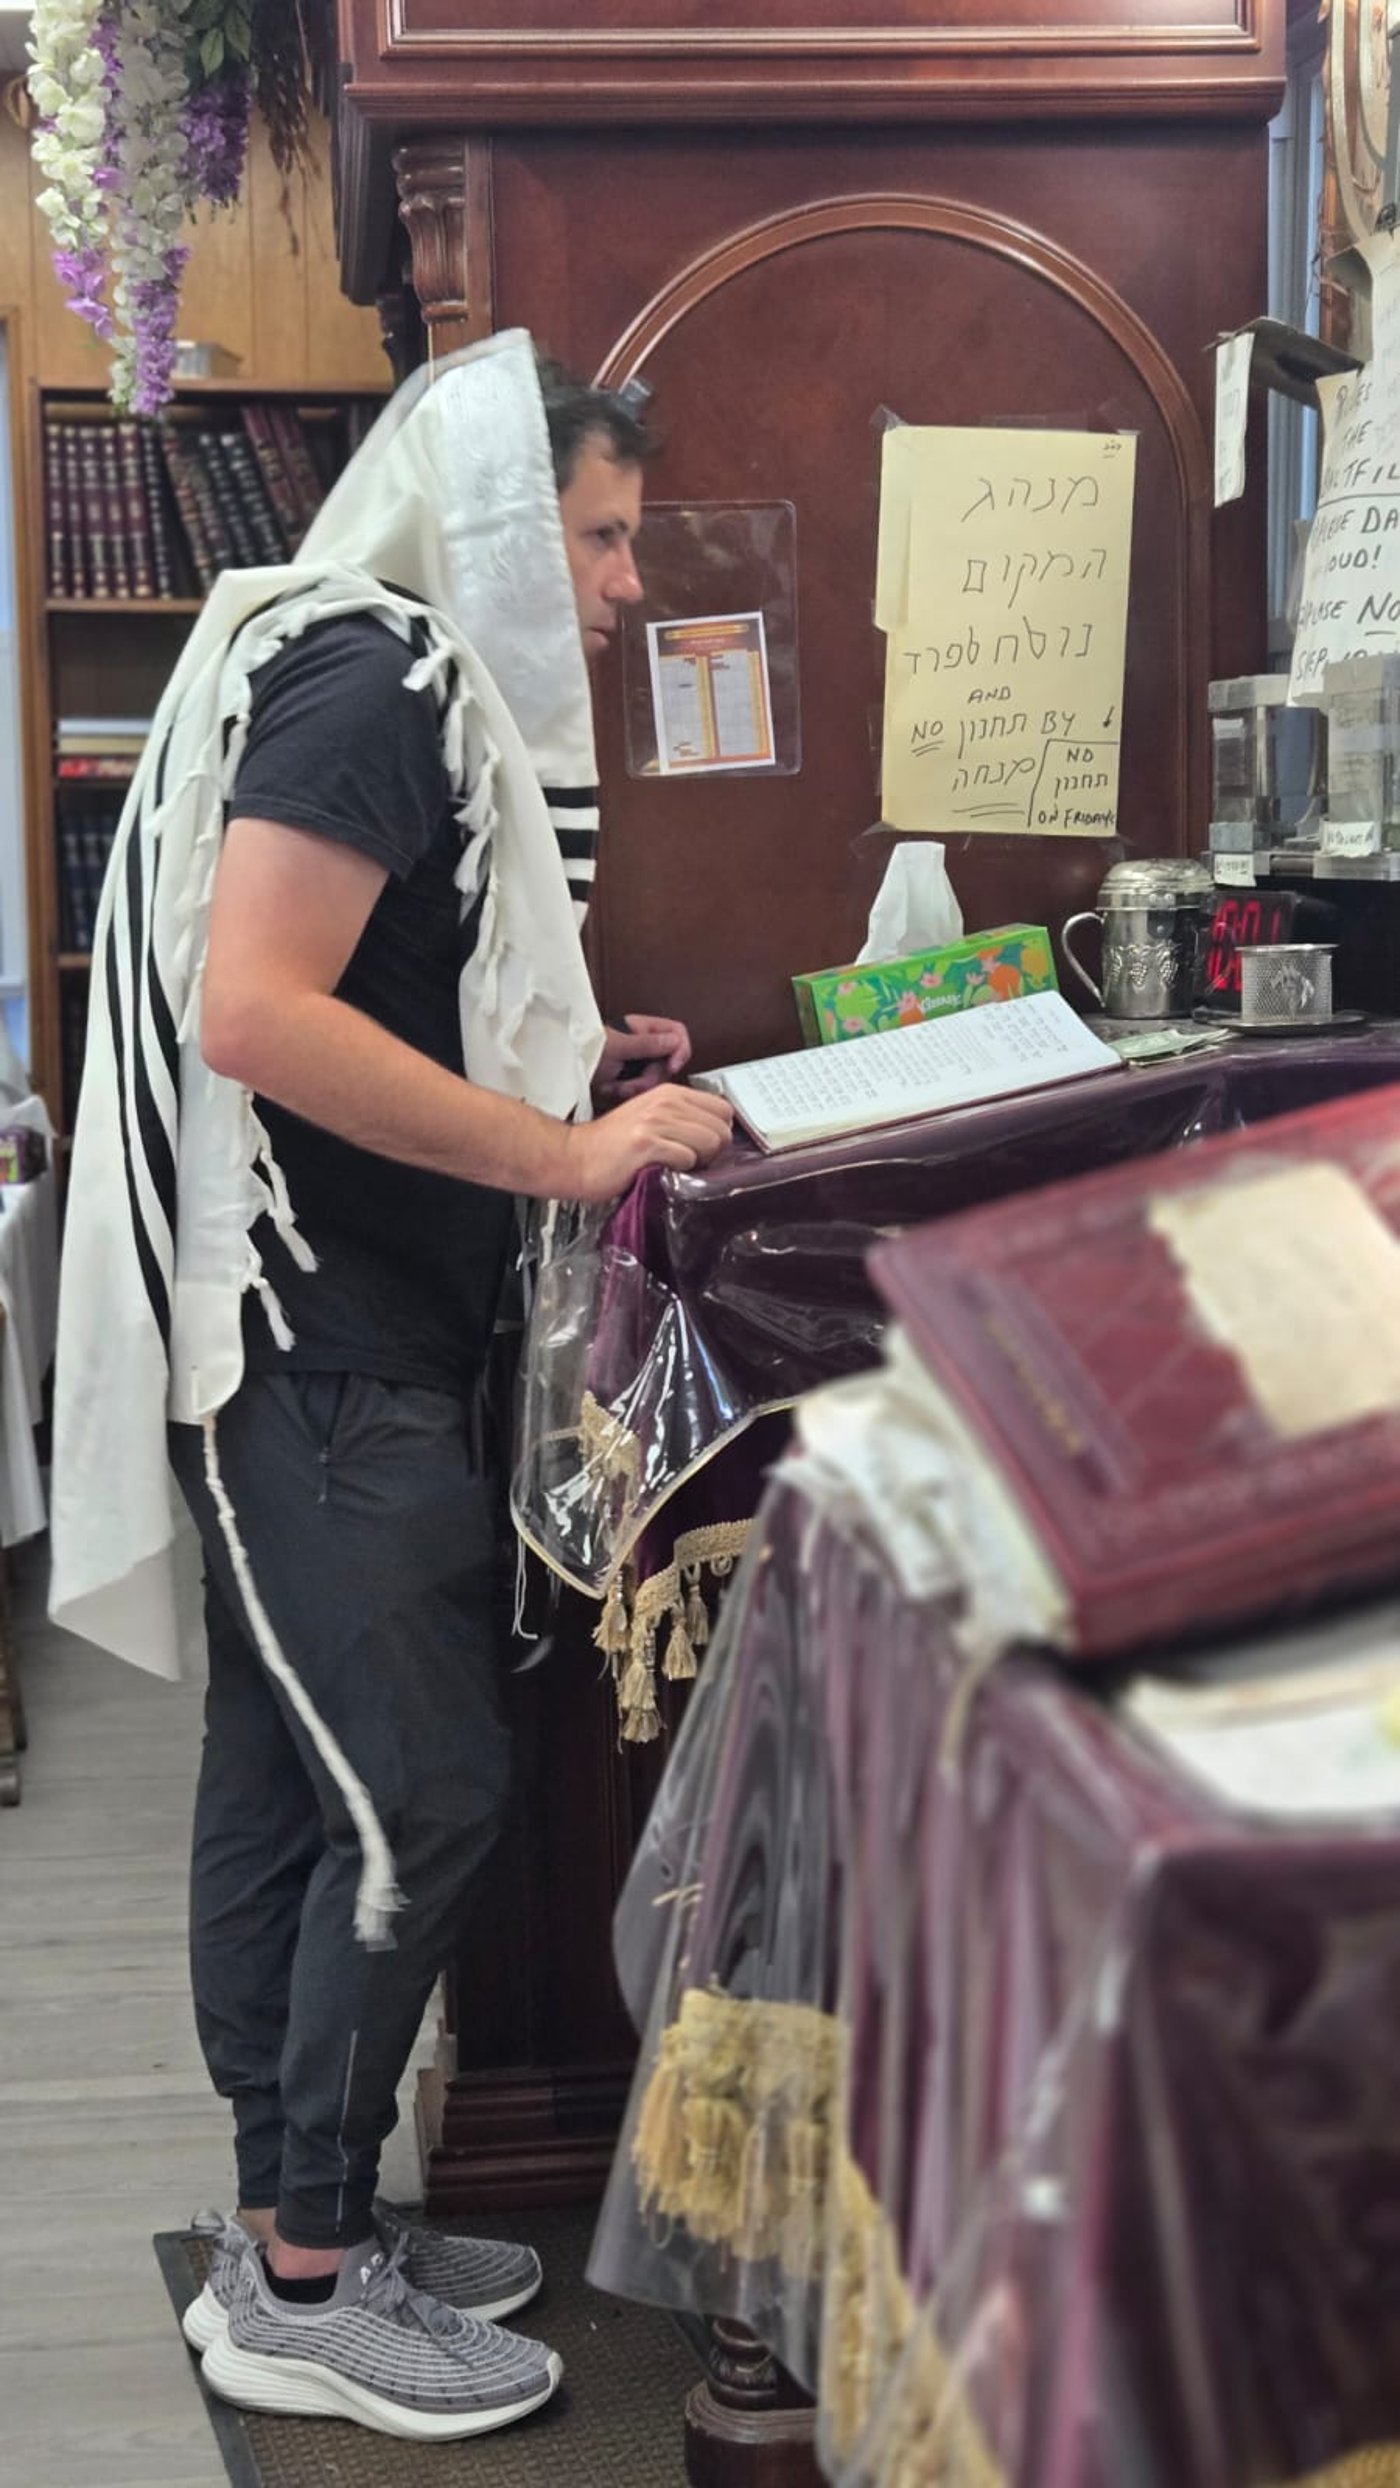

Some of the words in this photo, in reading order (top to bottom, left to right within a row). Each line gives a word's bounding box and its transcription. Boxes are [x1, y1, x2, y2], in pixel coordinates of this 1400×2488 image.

[961, 475, 1099, 523] מנהג
[962, 548, 1107, 610] המקום
[967, 686, 1012, 705] AND
[910, 720, 944, 745] NO
[957, 713, 1028, 760] תחנון
[1040, 710, 1076, 737] BY
[1066, 747, 1094, 764] NO
[952, 757, 1036, 792] מנחה
[1053, 772, 1108, 800] תחנון
[1038, 803, 1059, 824] ON
